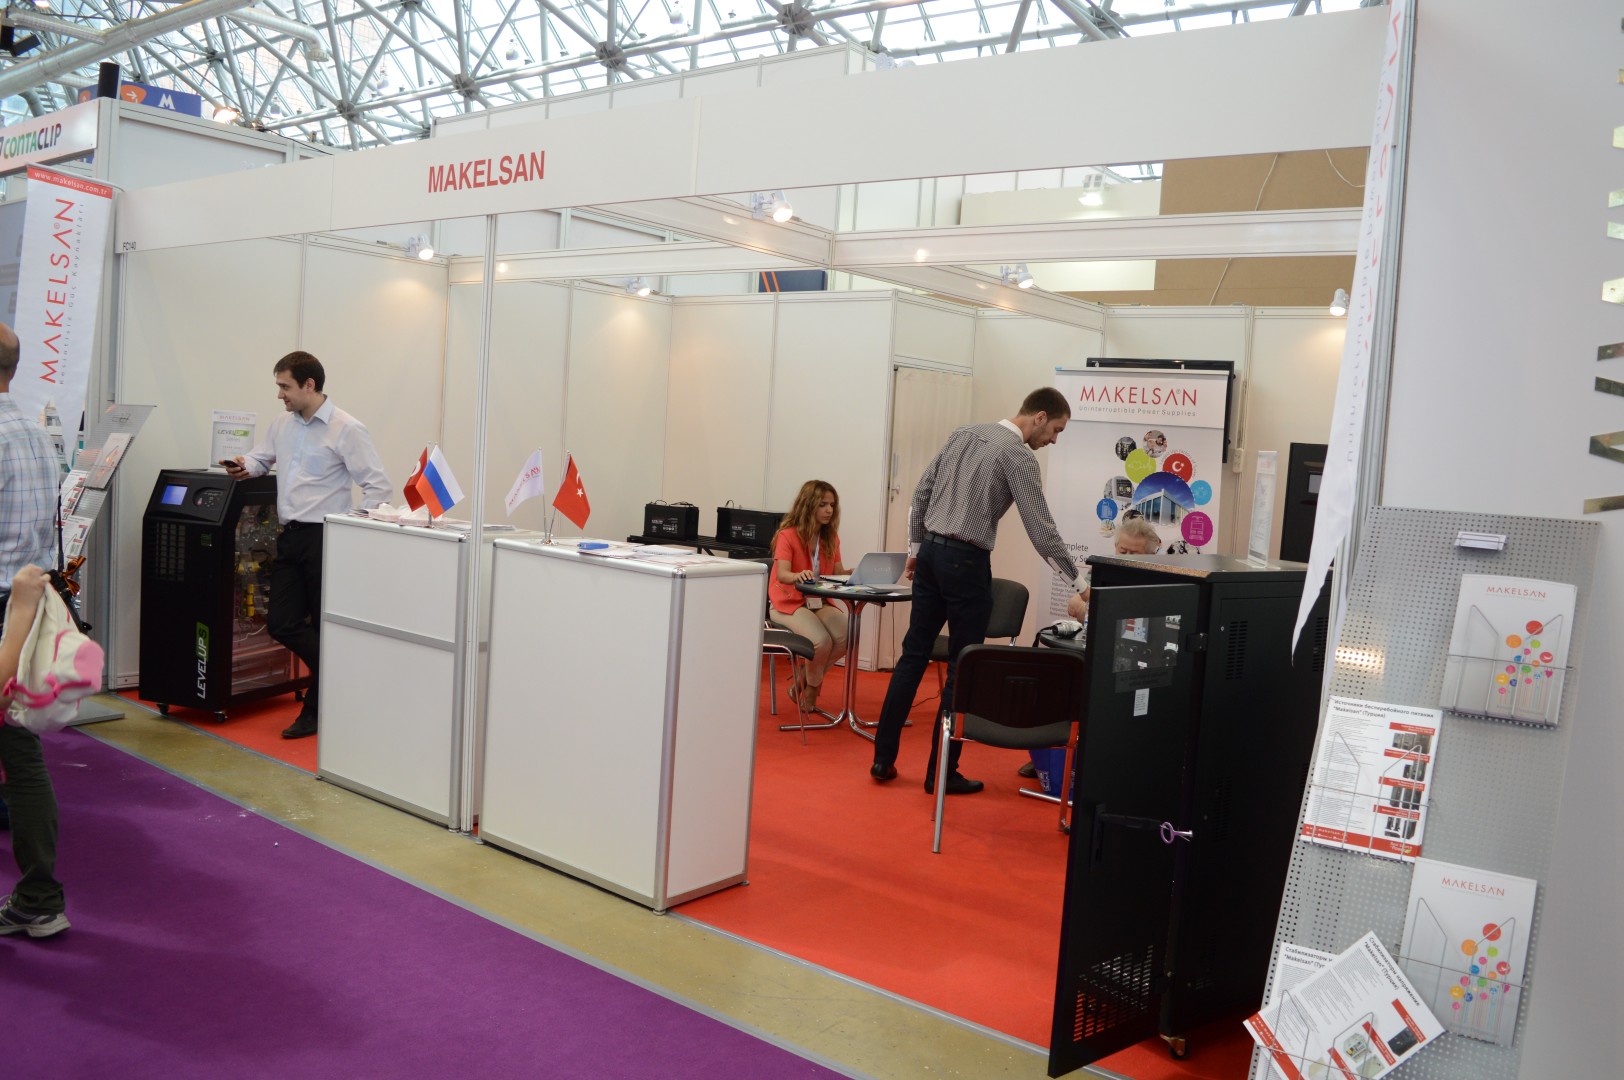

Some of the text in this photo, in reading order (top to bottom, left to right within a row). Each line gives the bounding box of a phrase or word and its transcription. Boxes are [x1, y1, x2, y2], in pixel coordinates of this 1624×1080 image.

[428, 150, 545, 193] MAKELSAN
[34, 171, 108, 195] www.makelsan.com.tr
[39, 199, 75, 384] MAKELSAN
[1080, 385, 1197, 406] MAKELSAN
[1079, 405, 1135, 414] Uninterruptible
[1161, 409, 1196, 417] Supplies
[1065, 543, 1089, 552] mplete
[1486, 586, 1546, 599] MAKELSAN
[1441, 877, 1505, 896] MAKELSAN
[1285, 946, 1328, 961] Стабилизаторы
